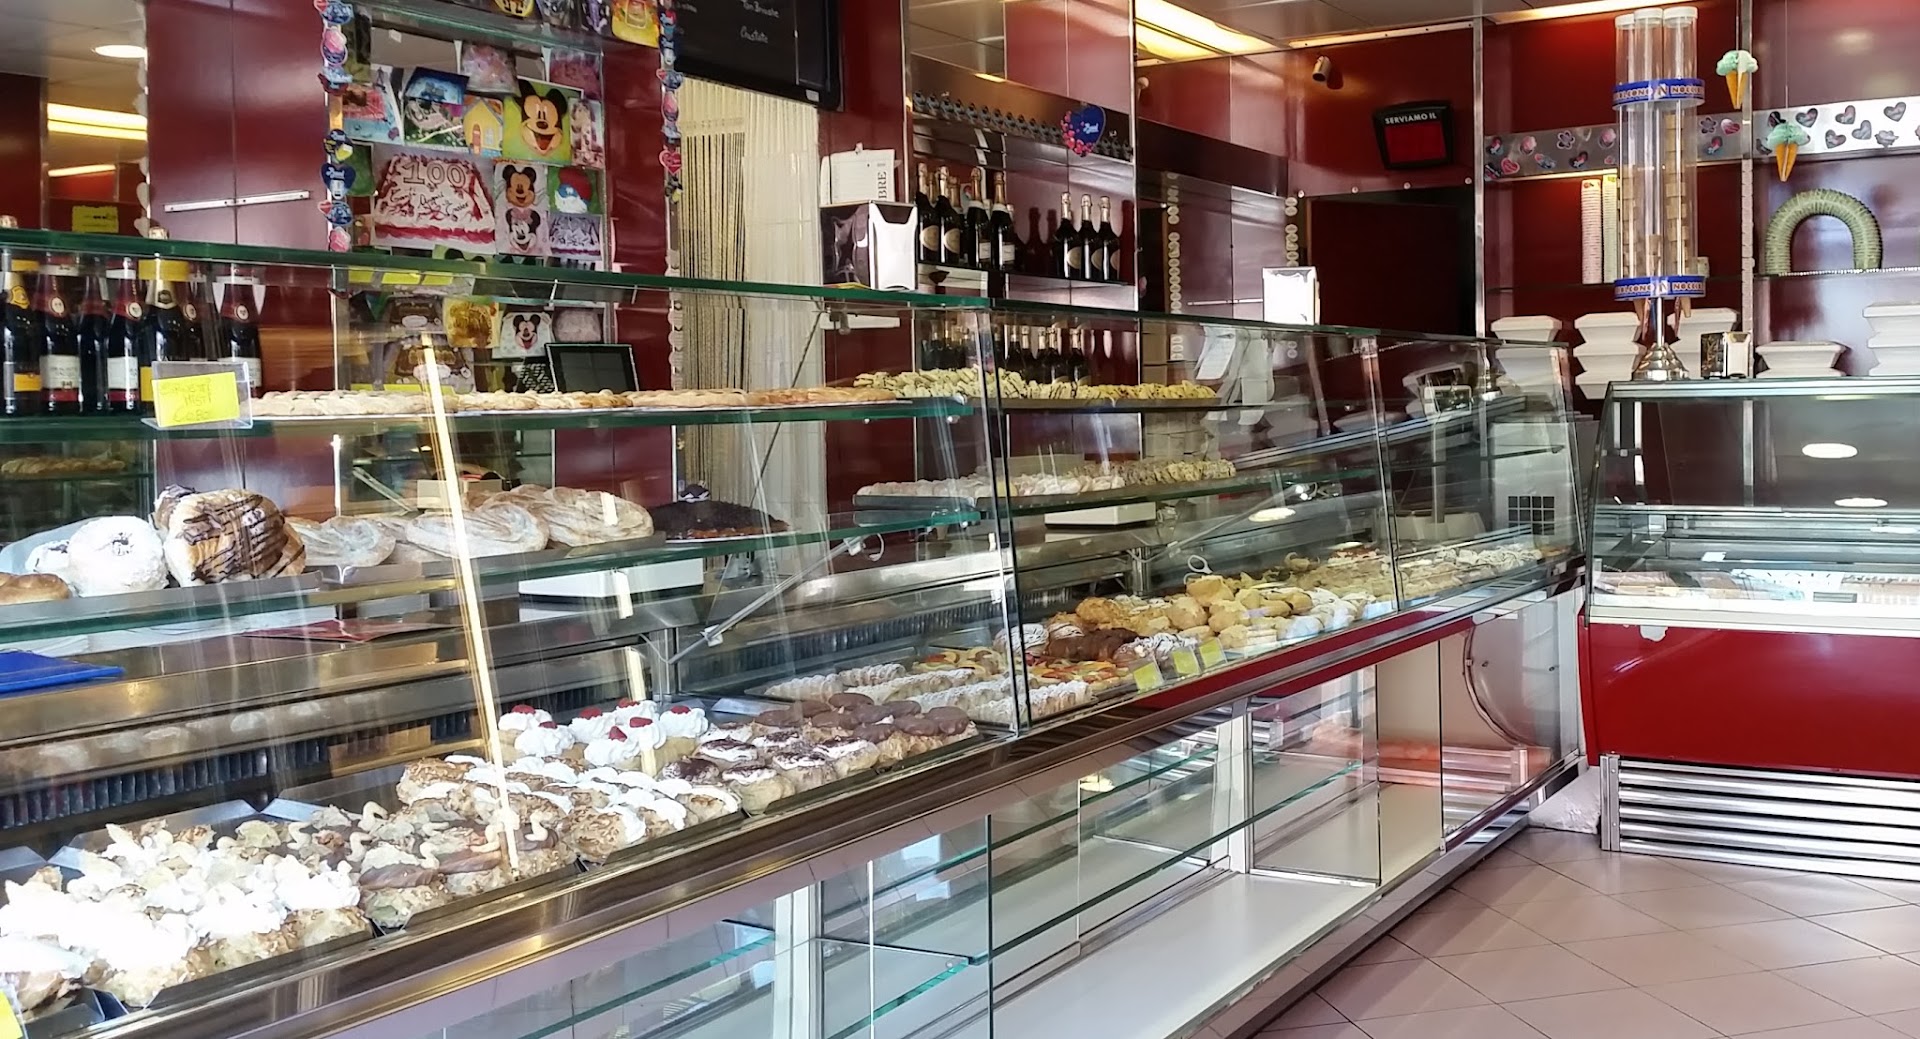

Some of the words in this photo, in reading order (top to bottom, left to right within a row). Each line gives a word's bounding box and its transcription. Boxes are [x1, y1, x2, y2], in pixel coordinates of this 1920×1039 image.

[1384, 112, 1428, 124] SERVIAMO
[402, 161, 466, 188] 100
[877, 171, 888, 199] BRE
